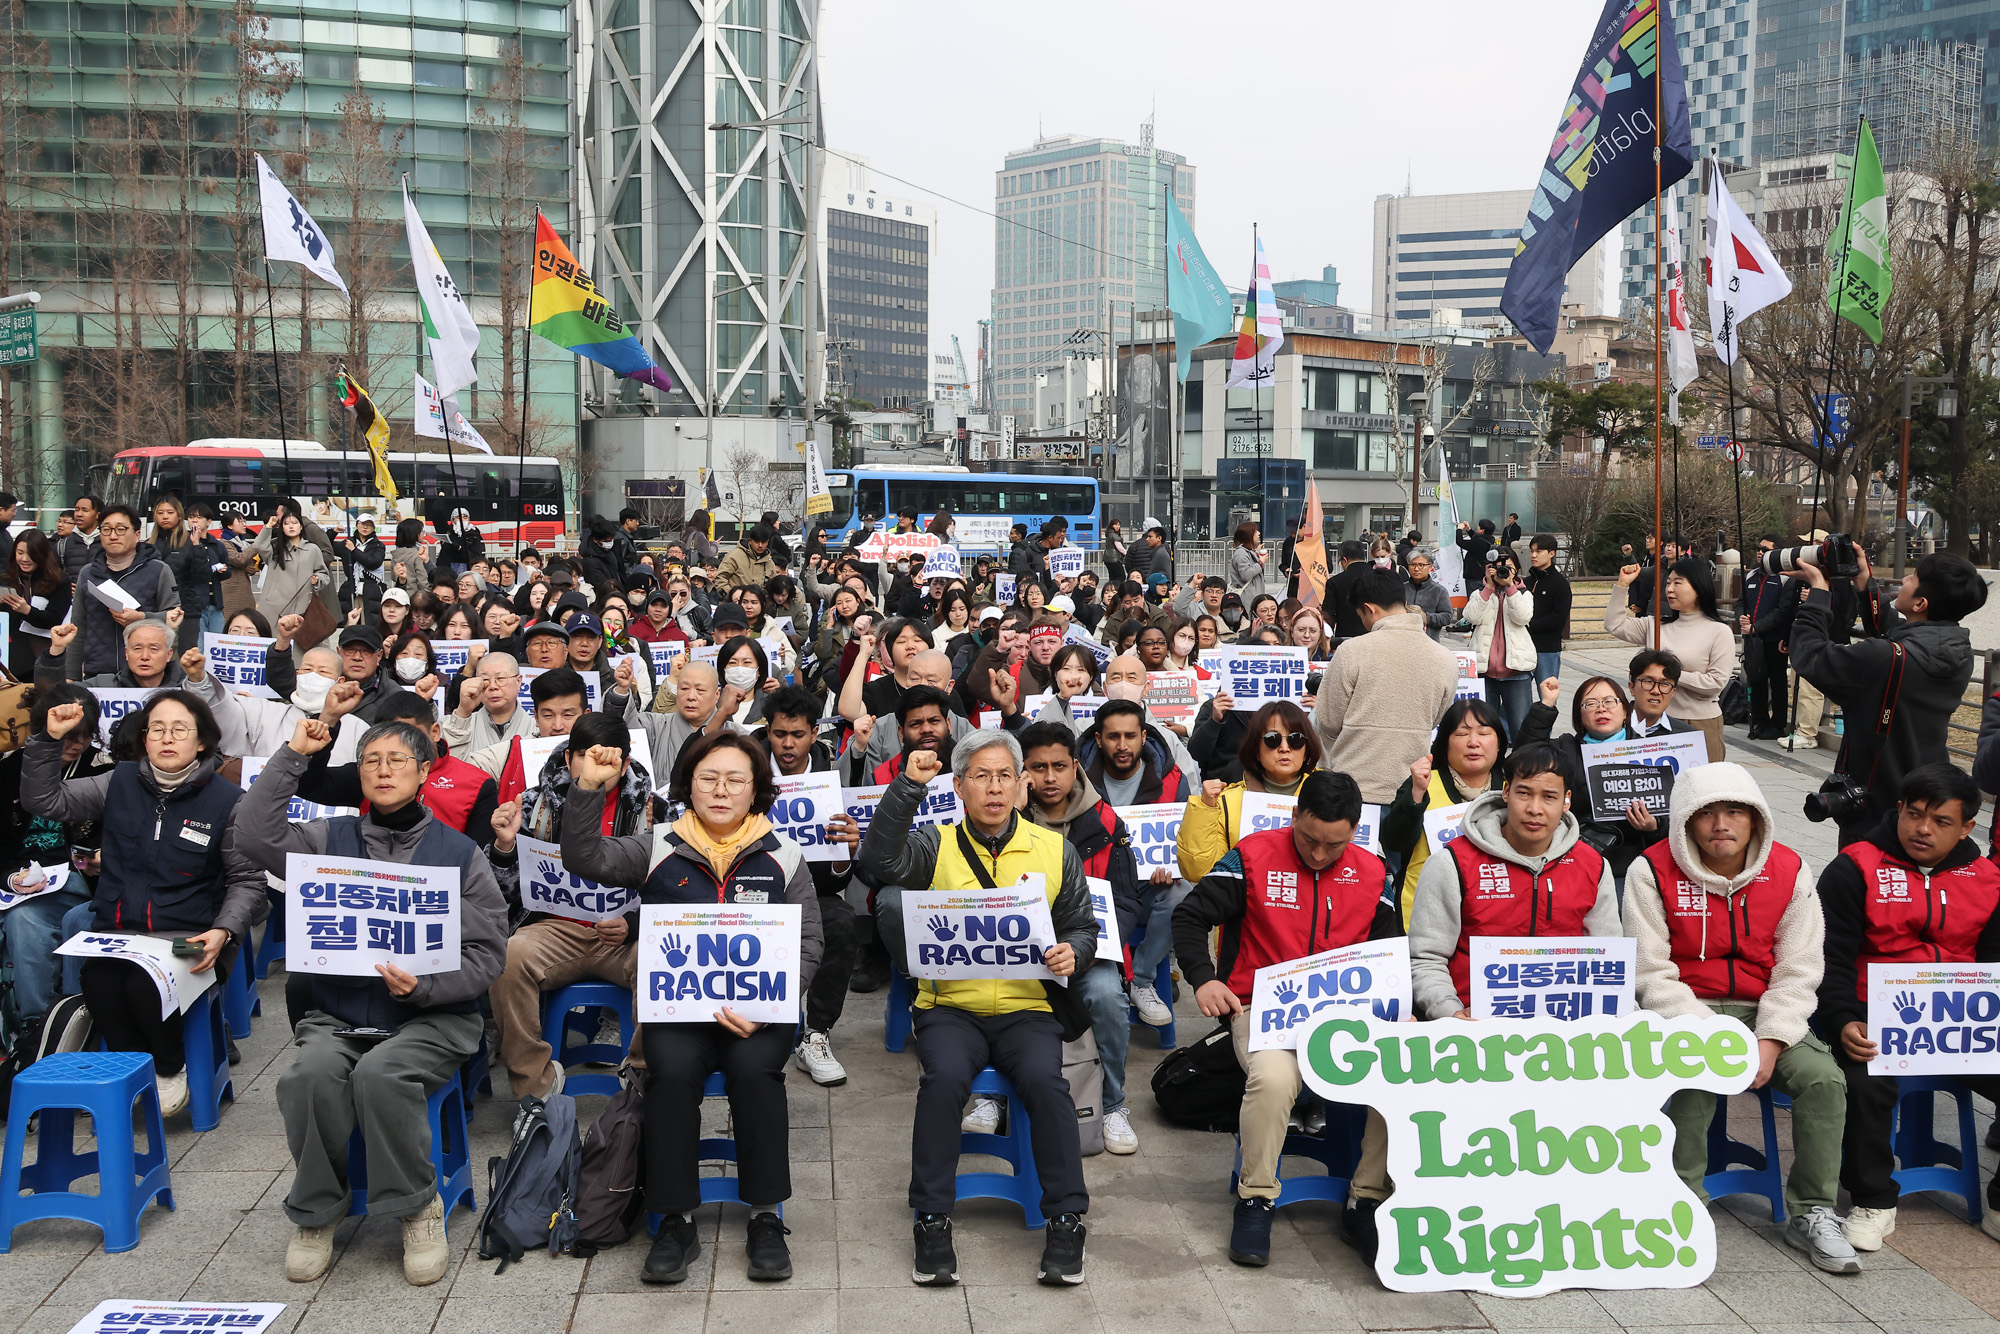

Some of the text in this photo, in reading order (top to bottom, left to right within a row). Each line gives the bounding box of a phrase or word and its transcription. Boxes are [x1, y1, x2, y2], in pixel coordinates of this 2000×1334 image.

[1475, 426, 1527, 436] TEXAS BARBECUE
[1043, 442, 1082, 458] 장작구이
[1418, 486, 1435, 497] LIVE
[218, 501, 258, 517] 9301
[1029, 517, 1043, 527] 103
[868, 532, 939, 548] Abolish
[936, 552, 956, 563] NO
[922, 562, 961, 574] RACISM
[209, 646, 267, 664] 인종차
[435, 651, 467, 666] 종차
[1228, 659, 1305, 675] 인종차별
[1882, 708, 1891, 725] EOS
[1602, 777, 1663, 793] 예외 없이
[766, 797, 815, 825] NO
[1140, 820, 1182, 844] NO
[1267, 870, 1298, 887] 단결
[1478, 862, 1509, 878] 단결
[1876, 867, 1908, 882] 단결
[1478, 877, 1511, 893] 투쟁
[1879, 881, 1909, 898] 투쟁
[299, 882, 450, 915] 인종차별
[1266, 886, 1298, 903] 투쟁
[1677, 895, 1708, 911] 투쟁
[739, 912, 753, 920] Day
[964, 914, 1031, 942] NO
[696, 933, 761, 967] NO
[1309, 952, 1349, 965] International
[1288, 965, 1320, 976] Elimination
[1328, 957, 1348, 966] Racial
[1348, 951, 1394, 962] Discrimination
[1308, 966, 1373, 999] NO
[1483, 961, 1626, 989] 인종차별
[649, 970, 787, 1002] RACISM
[1932, 991, 2000, 1023] NO
[1881, 1026, 2000, 1056] RACIS
[1308, 1020, 1747, 1085] Guarantee
[1411, 1111, 1660, 1176] Labor
[1391, 1202, 1696, 1285] Rights!
[99, 1312, 265, 1327] 인종차별
